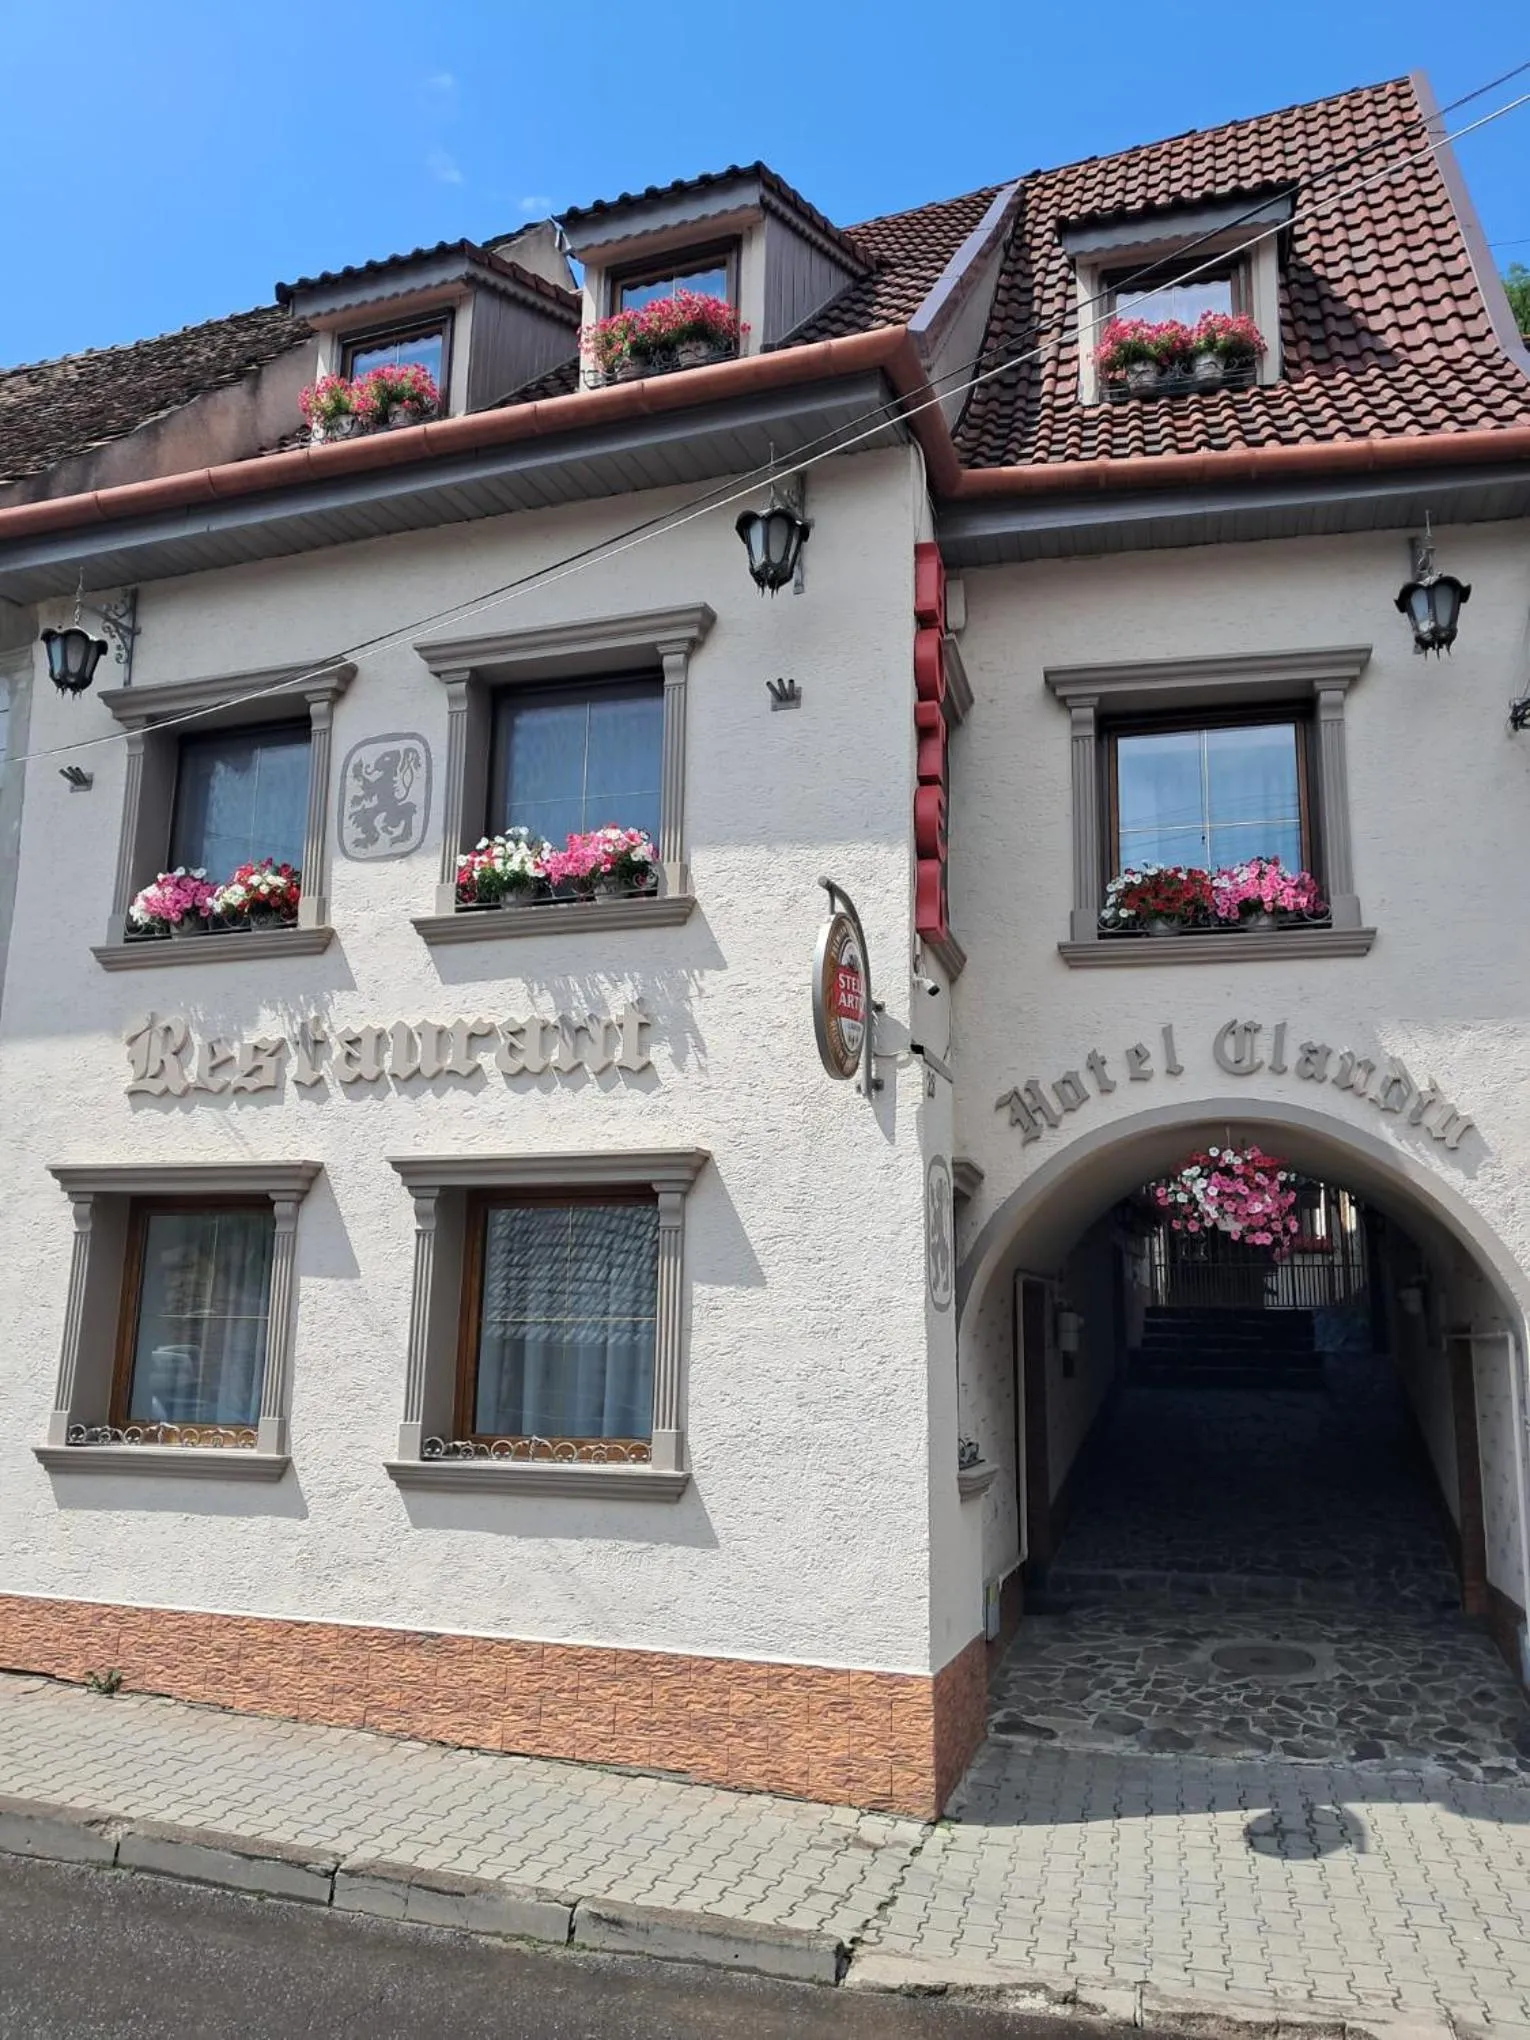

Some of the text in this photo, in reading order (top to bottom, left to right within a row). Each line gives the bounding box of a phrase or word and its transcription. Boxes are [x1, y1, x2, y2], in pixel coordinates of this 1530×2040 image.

[124, 998, 652, 1098] Restaurant
[994, 1018, 1475, 1150] Hotel Claudiu
